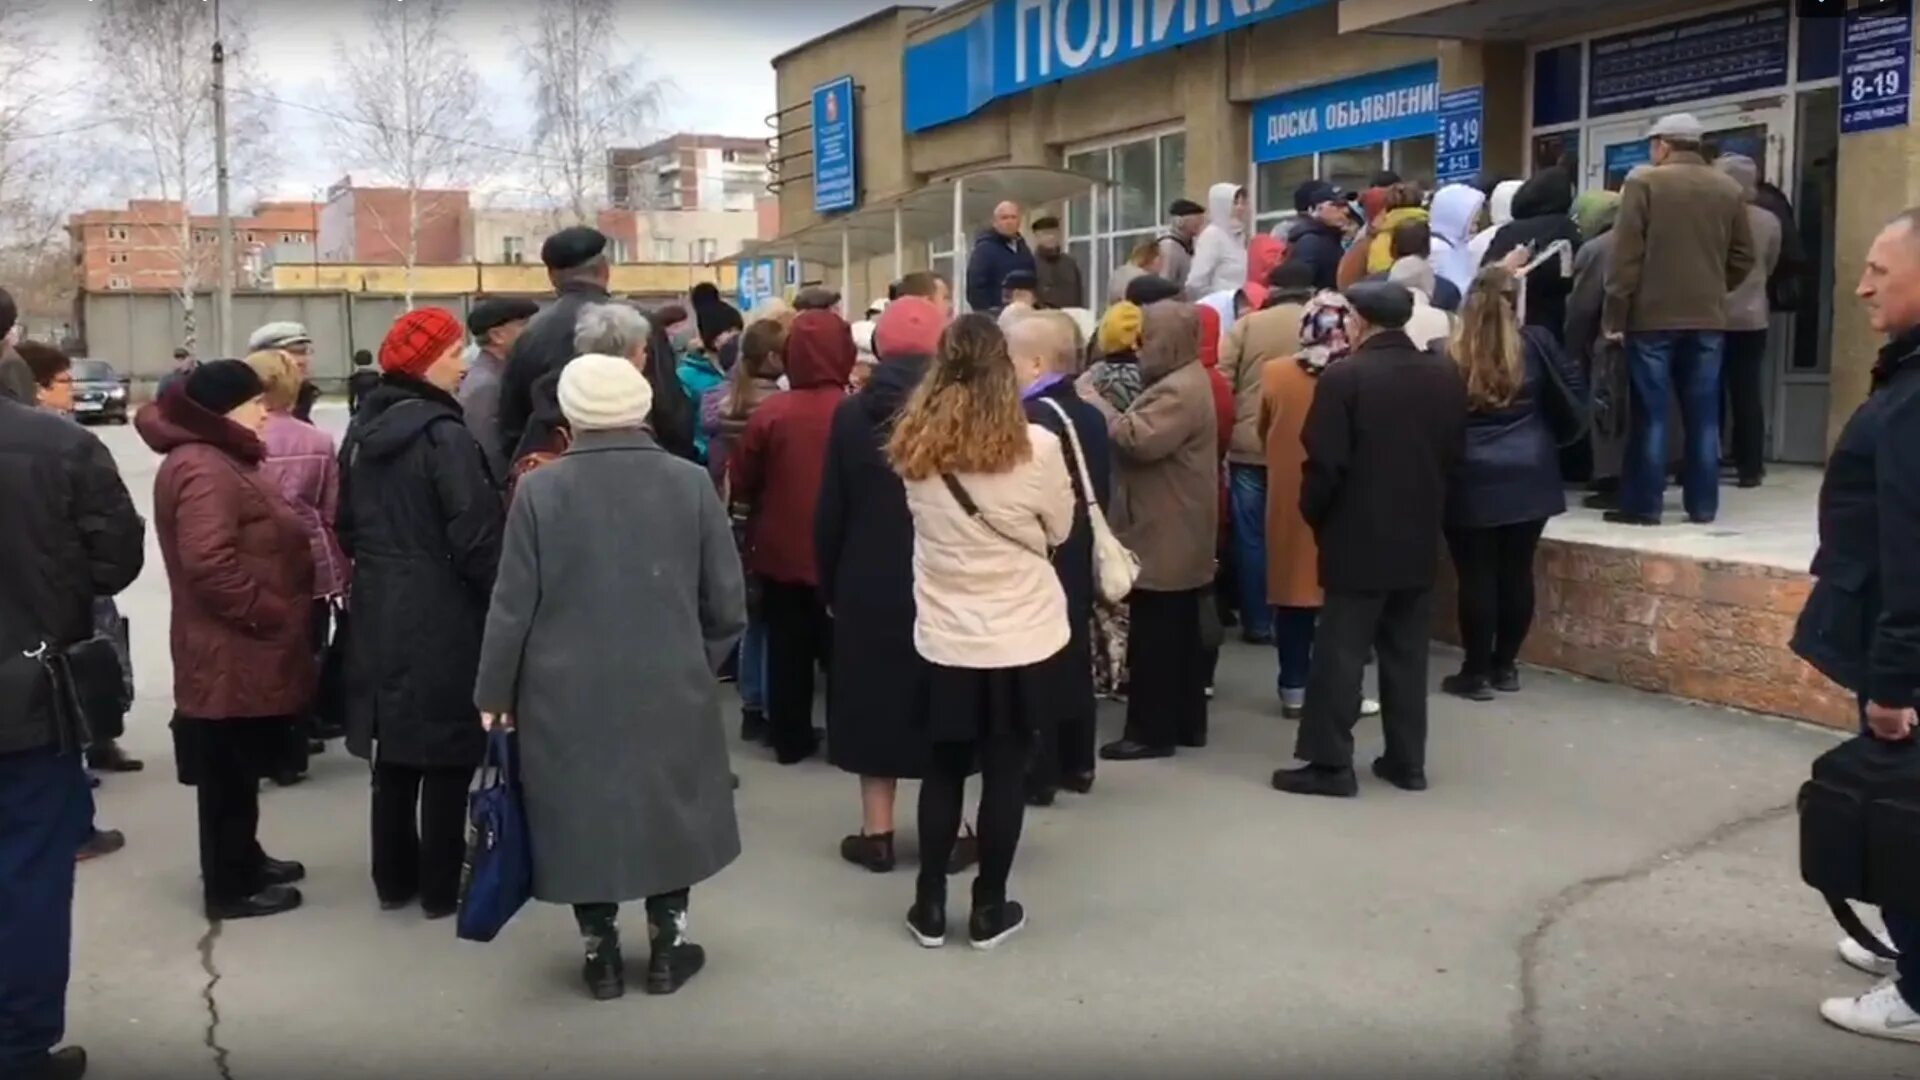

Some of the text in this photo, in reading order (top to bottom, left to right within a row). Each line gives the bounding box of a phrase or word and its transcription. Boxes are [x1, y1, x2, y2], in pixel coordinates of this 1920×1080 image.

[1015, 0, 1276, 82] ПОЛ
[1851, 70, 1899, 100] 8-19
[1267, 107, 1318, 146] ДОСКА
[1449, 118, 1478, 148] 8-19
